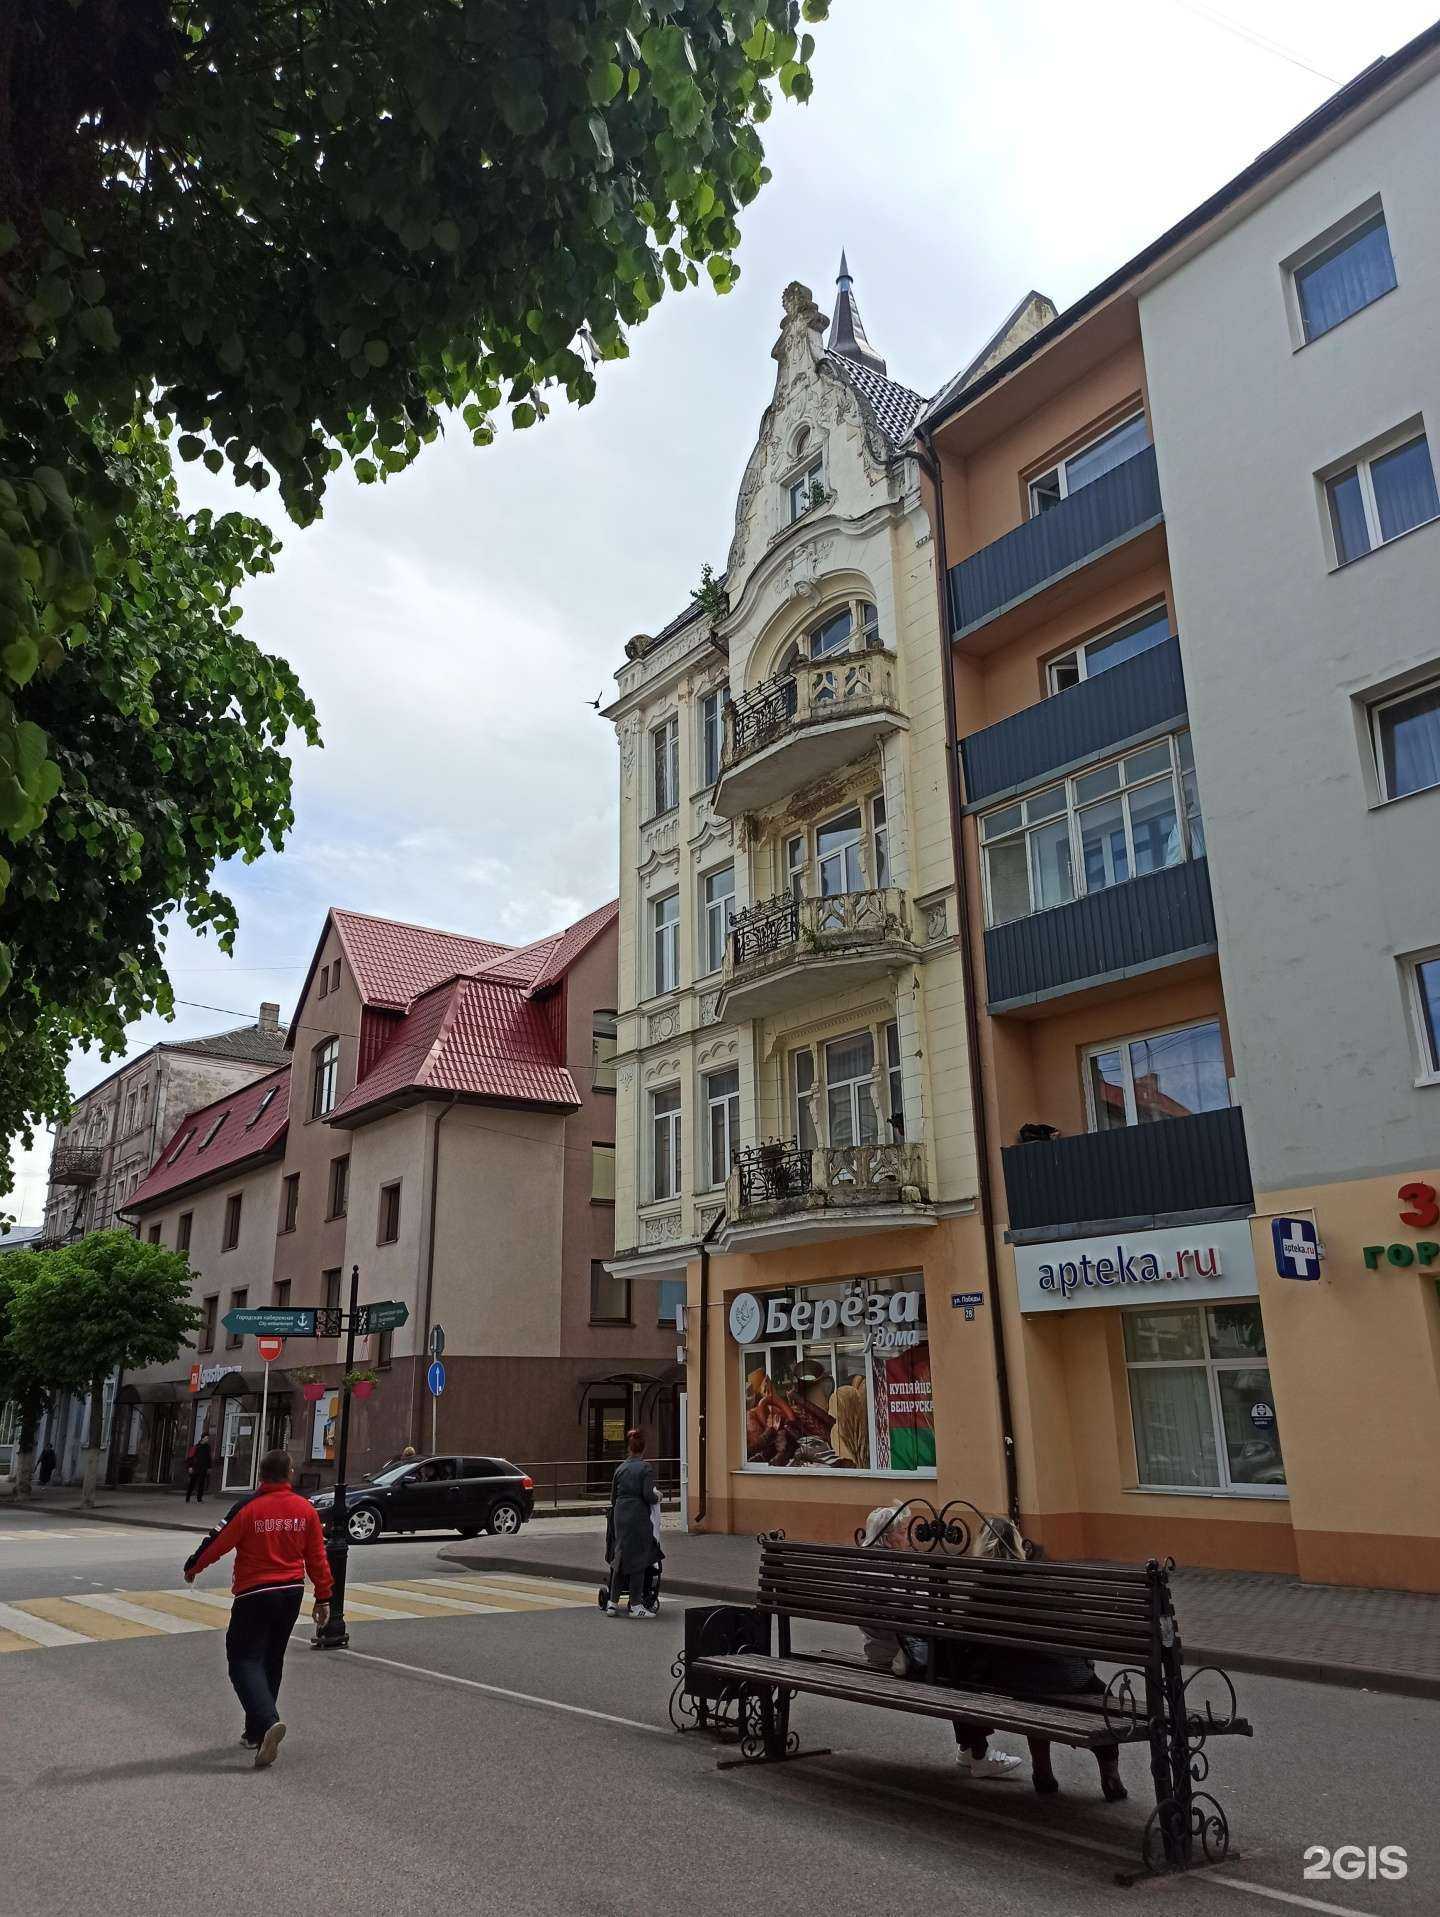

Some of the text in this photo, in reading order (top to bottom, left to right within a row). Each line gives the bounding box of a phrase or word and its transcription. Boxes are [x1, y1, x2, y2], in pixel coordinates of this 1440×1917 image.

[1284, 1243, 1315, 1255] apteka.ru
[1038, 1245, 1220, 1297] apteka.ru
[962, 1294, 981, 1303] Победы
[765, 1286, 920, 1341] Берёза
[876, 1326, 920, 1346] дома
[254, 1517, 306, 1533] RUSSIA
